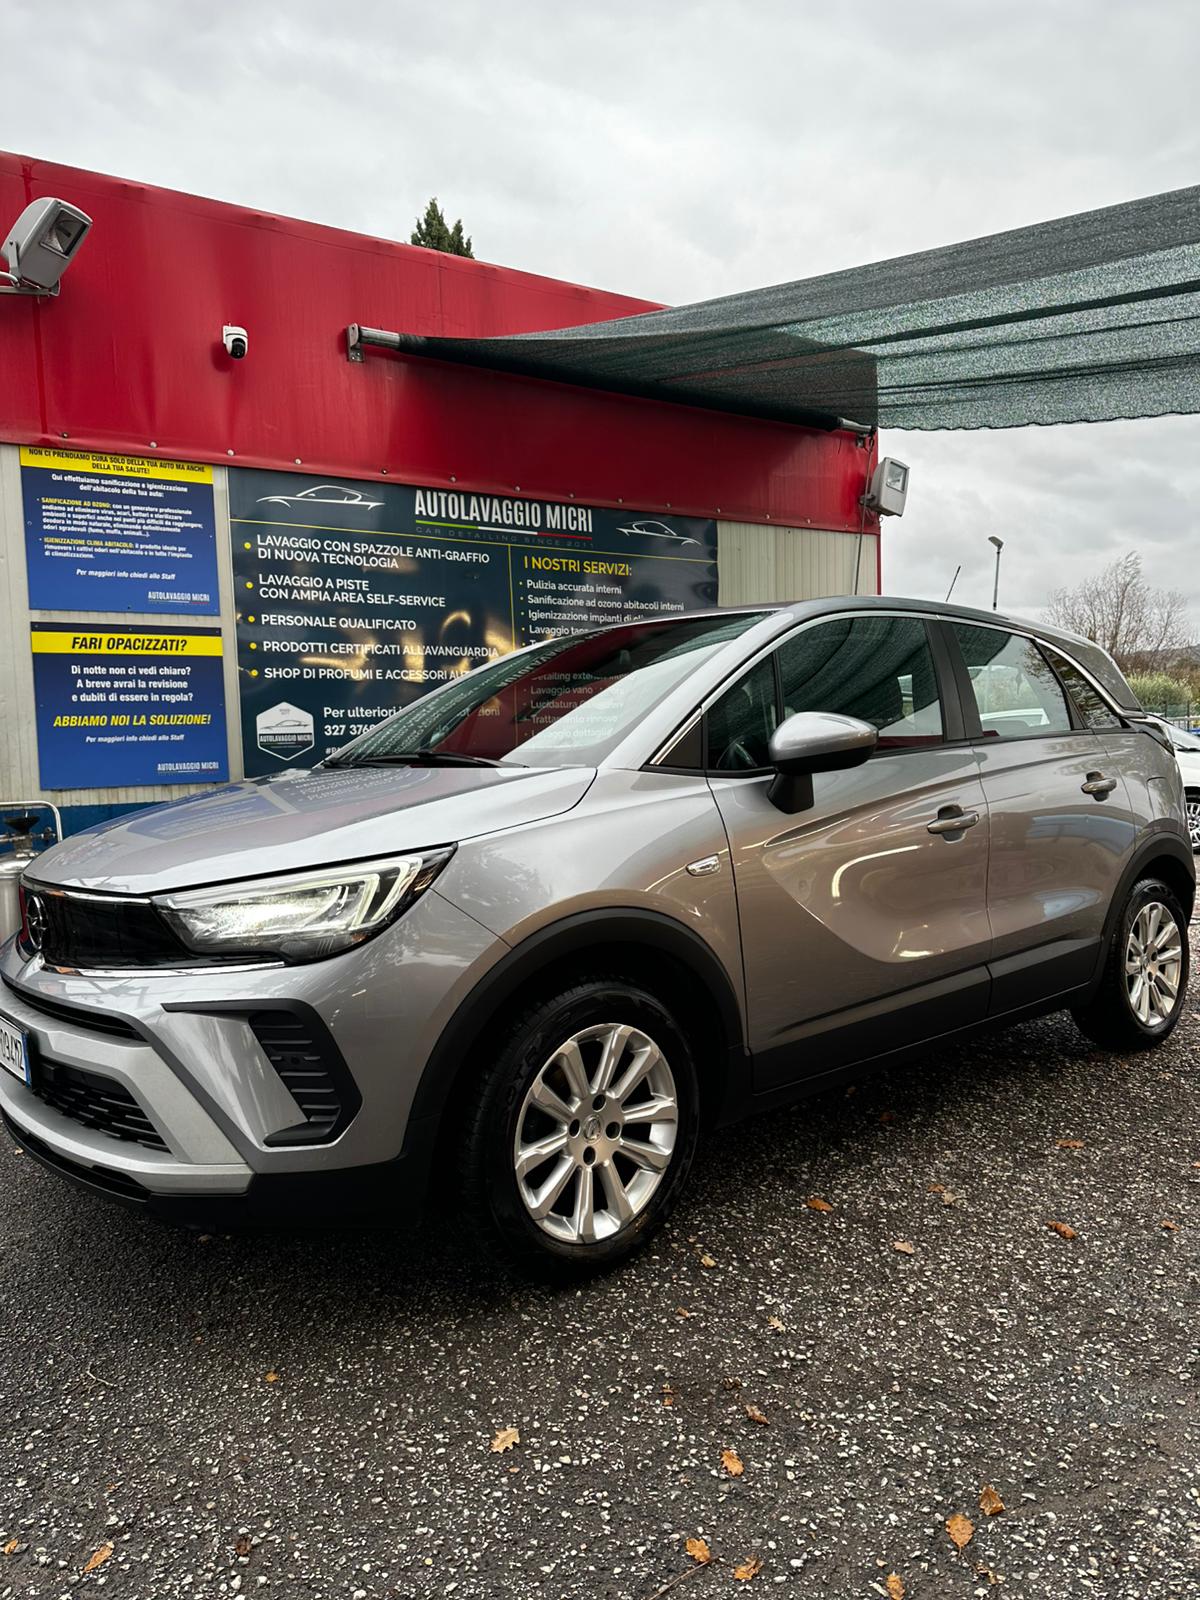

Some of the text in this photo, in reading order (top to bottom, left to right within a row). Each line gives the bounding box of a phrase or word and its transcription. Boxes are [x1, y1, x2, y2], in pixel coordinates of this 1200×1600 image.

[53, 450, 90, 460] PRENDIAMO
[110, 456, 125, 464] SOLO
[127, 458, 145, 466] DELLA
[160, 462, 174, 470] AUTO
[186, 464, 205, 472] ANCHE
[113, 464, 124, 472] TUA
[126, 466, 150, 474] SALUTE!
[64, 474, 99, 484] effettuiamo
[101, 478, 140, 488] sanificazione
[147, 483, 188, 492] igienizzazione
[80, 484, 120, 494] dell'abitacolo
[415, 490, 593, 532] AUTOLAVAGGIO MICRI
[416, 527, 441, 536] CAR
[448, 530, 518, 542] DETAILING
[524, 538, 560, 546] SINCE
[256, 535, 490, 564] LAVAGGIO CON SPAZZOLE ANTI-GRAFFIO
[258, 548, 399, 569] DI NUOVA TECNOLOGIA
[524, 555, 633, 576] I NOSTRI SERVIZI:
[88, 570, 116, 578] maggiori
[130, 571, 148, 579] chiedi
[259, 574, 370, 591] LAVAGGIO A PISTE
[527, 580, 622, 595] Pulizia accurata interni
[148, 591, 210, 602] AUTOLAVAGGIO MICRI
[259, 588, 446, 607] CON AMPIA AREA SELF-SERVICE
[528, 594, 685, 612] Sanificazione ad ozono abitacoli interni
[261, 614, 416, 631] PERSONALE QUALIFICATO
[528, 610, 588, 621] Igienizzazione
[589, 612, 623, 624] impianti
[529, 625, 569, 636] Lavaggio
[72, 637, 187, 651] FARI OPACIZZATI?
[263, 641, 499, 657] PRODOTTI CERTIFICATI ALL'AVANGUARDIA
[72, 665, 81, 674] Di
[83, 666, 106, 675] notte
[128, 666, 136, 675] ci
[138, 666, 156, 675] vedi
[159, 666, 191, 675] chiaro?
[264, 668, 300, 679] SHOP
[303, 669, 316, 679] DI
[319, 669, 373, 679] PROFUMI
[376, 670, 383, 679] E
[386, 670, 447, 680] ACCESSORI
[76, 679, 188, 688] A breve avrai la revisione
[531, 686, 570, 696] Lavaggio
[72, 694, 77, 702] e
[80, 693, 106, 702] dubiti
[109, 693, 117, 701] di
[151, 693, 159, 701] in
[162, 693, 193, 704] regola?
[531, 700, 578, 709] Lucidatura
[324, 707, 344, 718] Per
[348, 706, 396, 718] ulteriori
[54, 714, 211, 727] ABBIAMO NOI LA SOLUZIONE!
[324, 724, 346, 736] 327
[157, 762, 219, 770] AUTOLAVAGGIO MICRI
